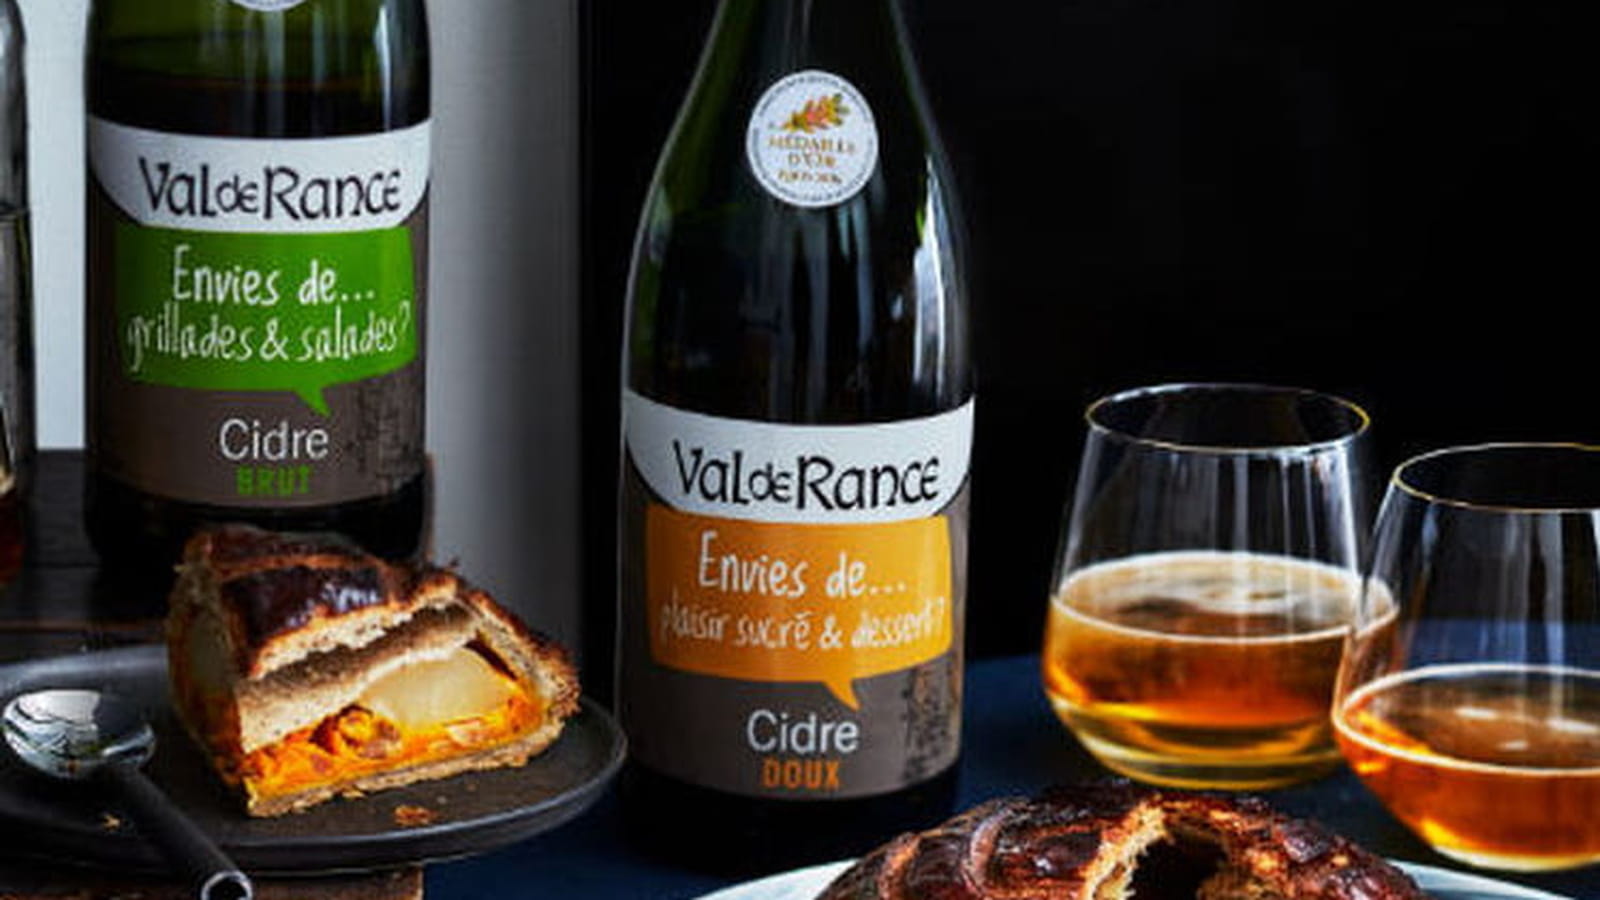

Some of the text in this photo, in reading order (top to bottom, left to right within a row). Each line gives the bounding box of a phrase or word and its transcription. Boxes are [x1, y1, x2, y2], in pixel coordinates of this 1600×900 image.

[173, 244, 375, 305] Envies de...
[127, 300, 254, 373] grillades
[259, 317, 289, 361] &
[219, 417, 329, 461] Cidre
[236, 465, 314, 496] BRUT
[699, 530, 907, 598] Envies de...
[659, 584, 732, 648] plaisir
[818, 614, 845, 651] &
[746, 709, 859, 752] Cidre
[762, 758, 841, 791] DOUX
